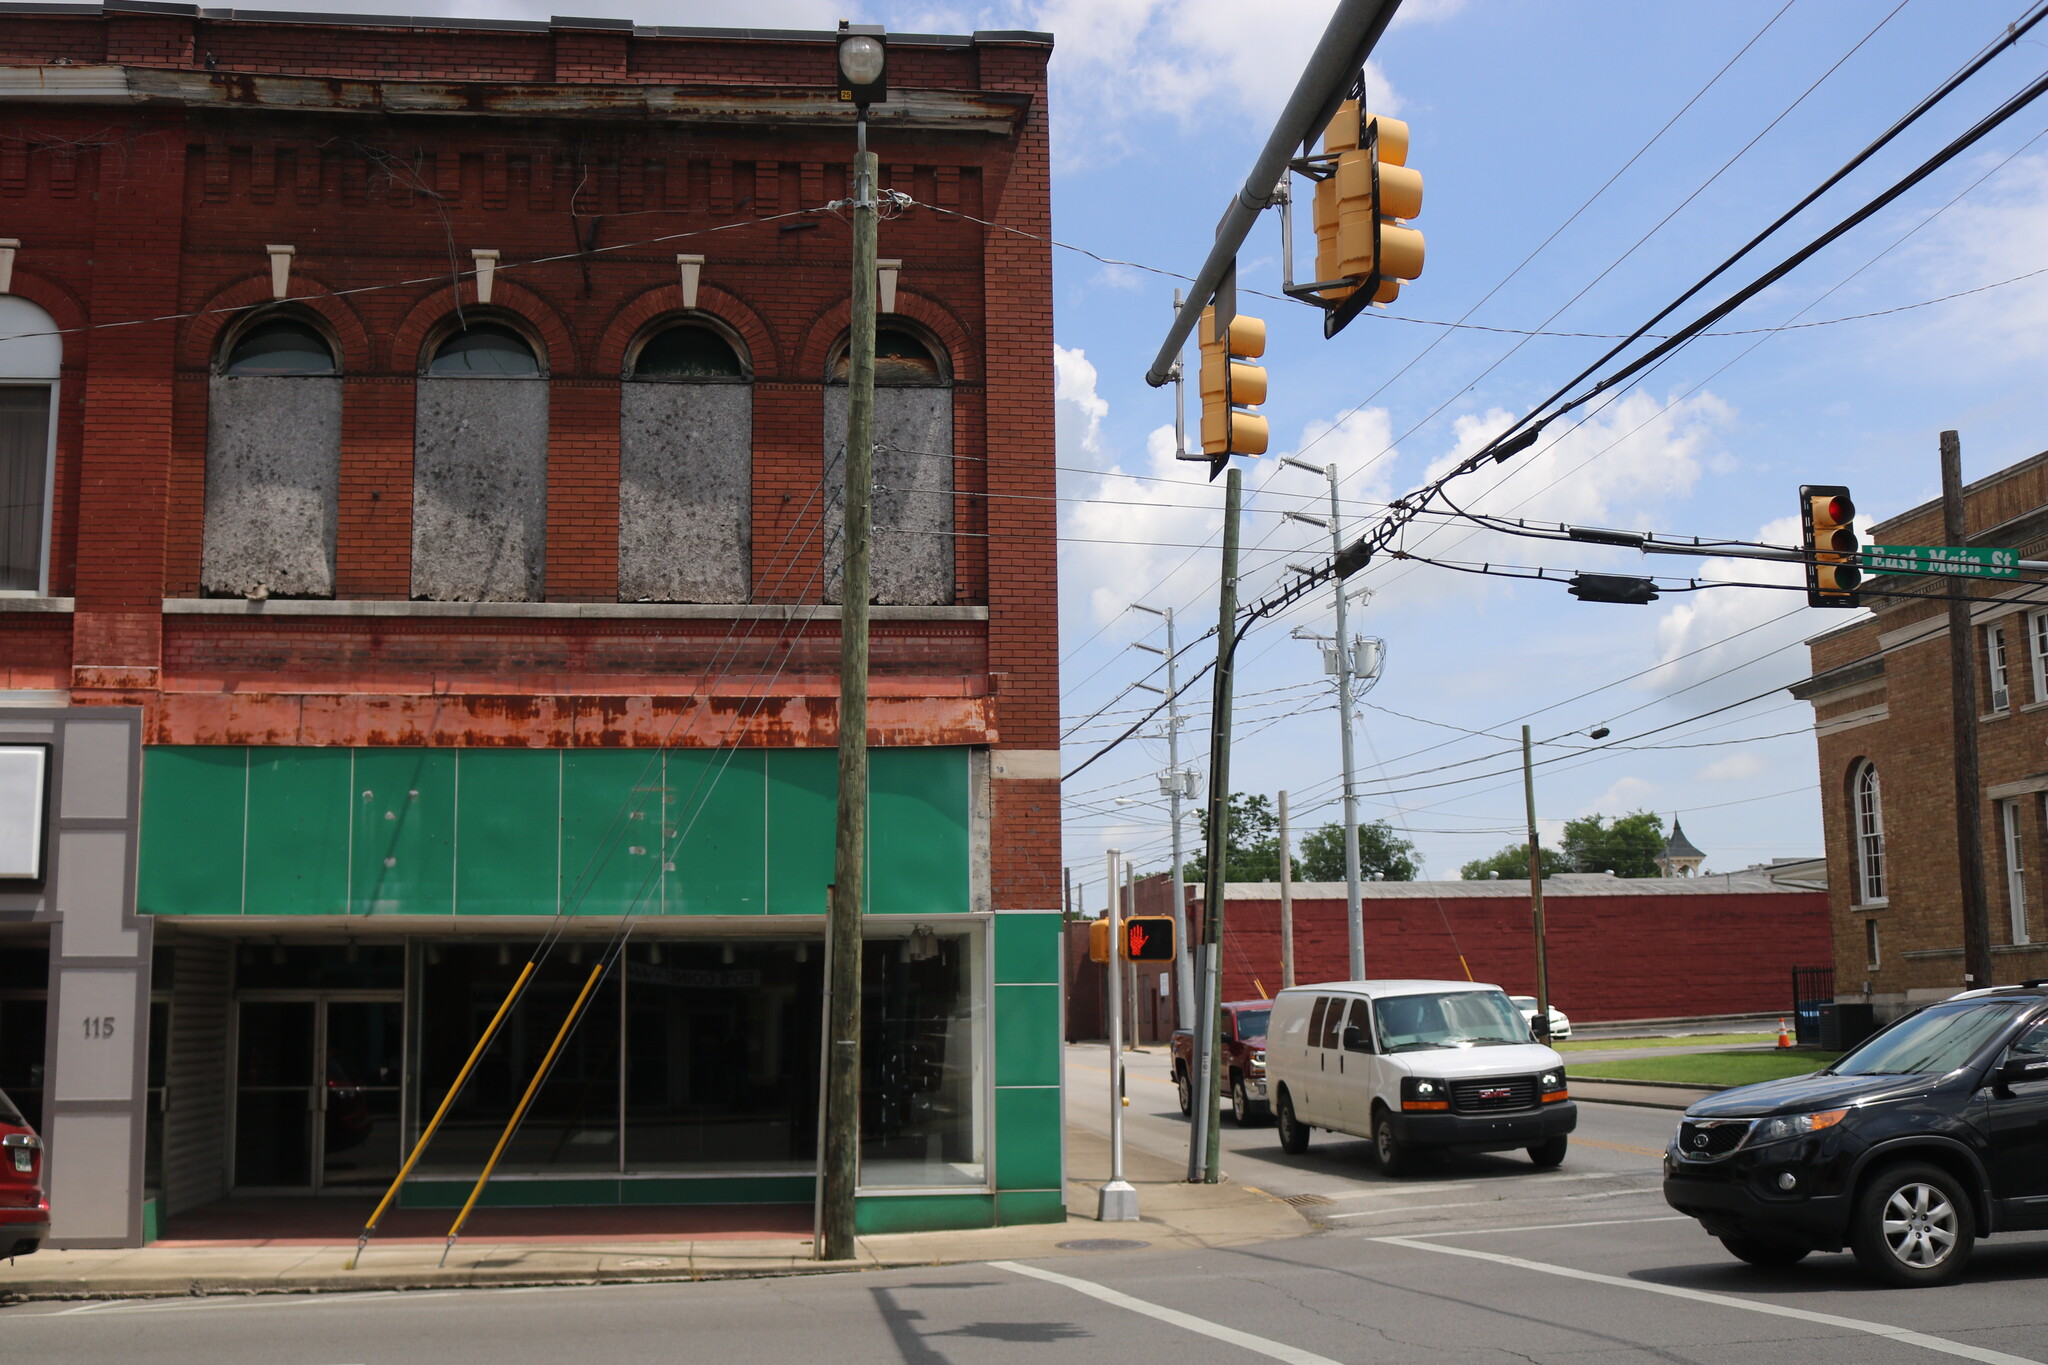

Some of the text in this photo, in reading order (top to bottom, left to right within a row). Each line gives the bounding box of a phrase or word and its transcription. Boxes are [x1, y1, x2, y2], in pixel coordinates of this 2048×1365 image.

[841, 91, 851, 99] 25
[1871, 547, 2012, 574] East Main St
[82, 1016, 115, 1039] 115
[1479, 1087, 1511, 1098] GMC
